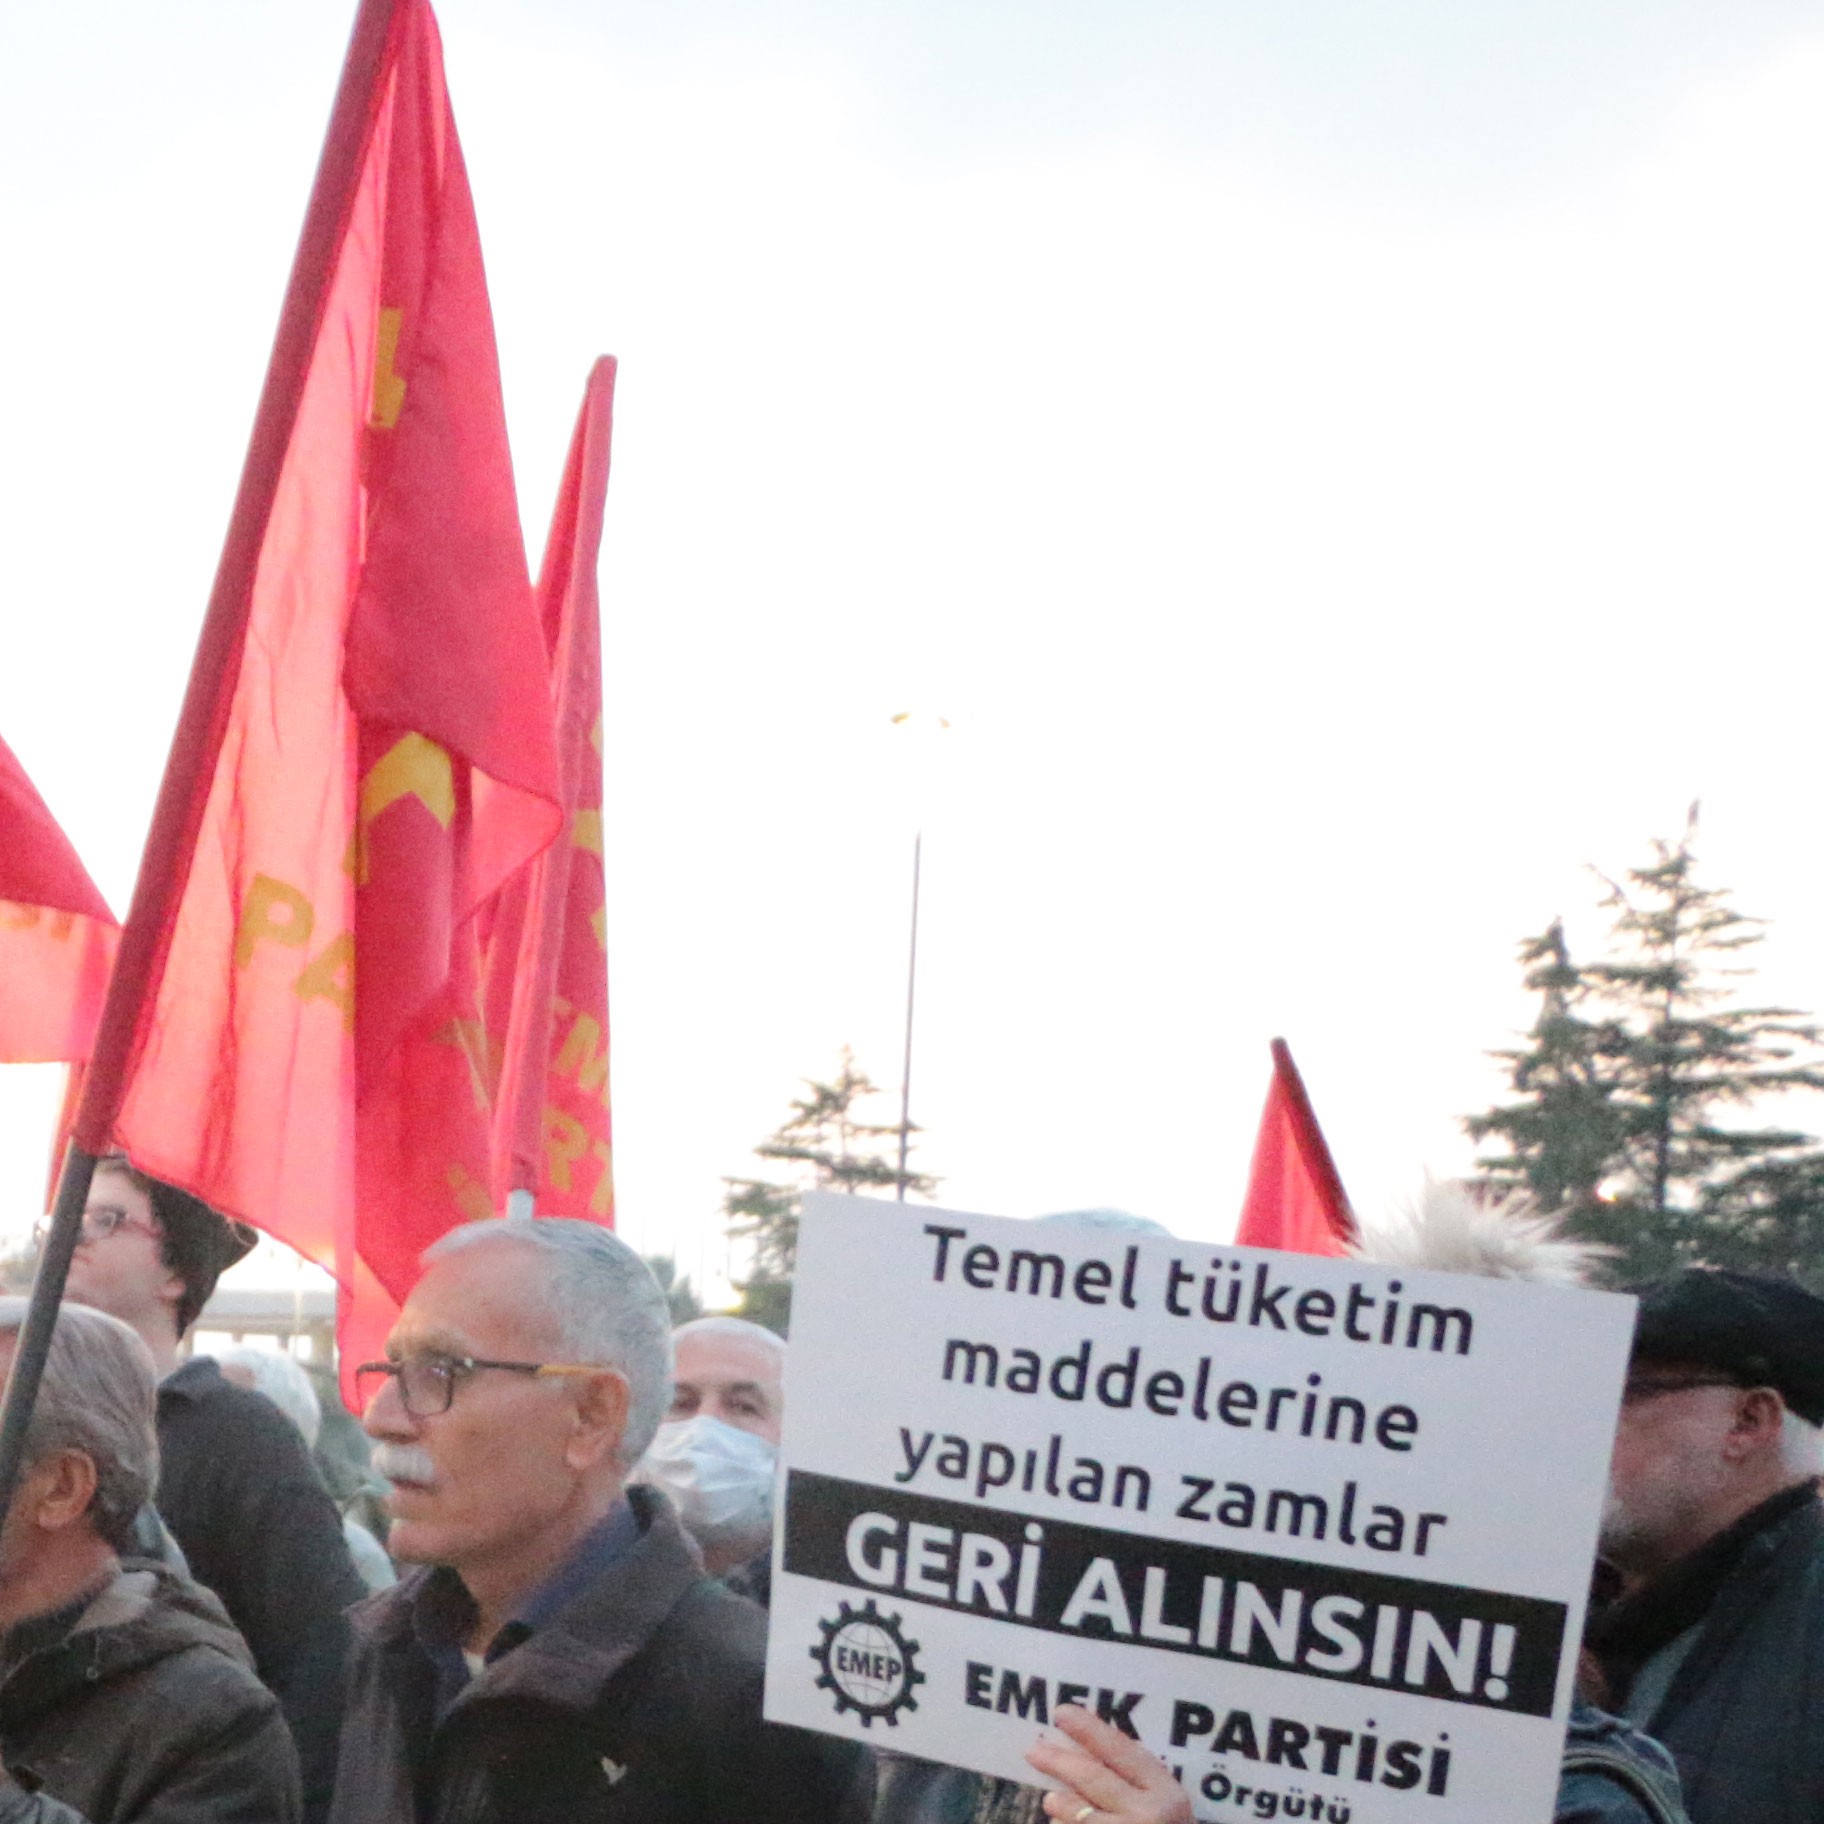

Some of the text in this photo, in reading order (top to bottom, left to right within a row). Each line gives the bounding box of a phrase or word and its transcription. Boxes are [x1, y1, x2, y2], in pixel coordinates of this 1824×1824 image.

[923, 1223, 1474, 1355] Temel tüketim
[942, 1337, 1419, 1452] maddelerine
[894, 1426, 1447, 1557] yapılan zamlar
[836, 1646, 903, 1684] EMEP
[845, 1511, 1518, 1700] GERİ ALINSIN!
[1169, 1699, 1452, 1797] PARTİSİ
